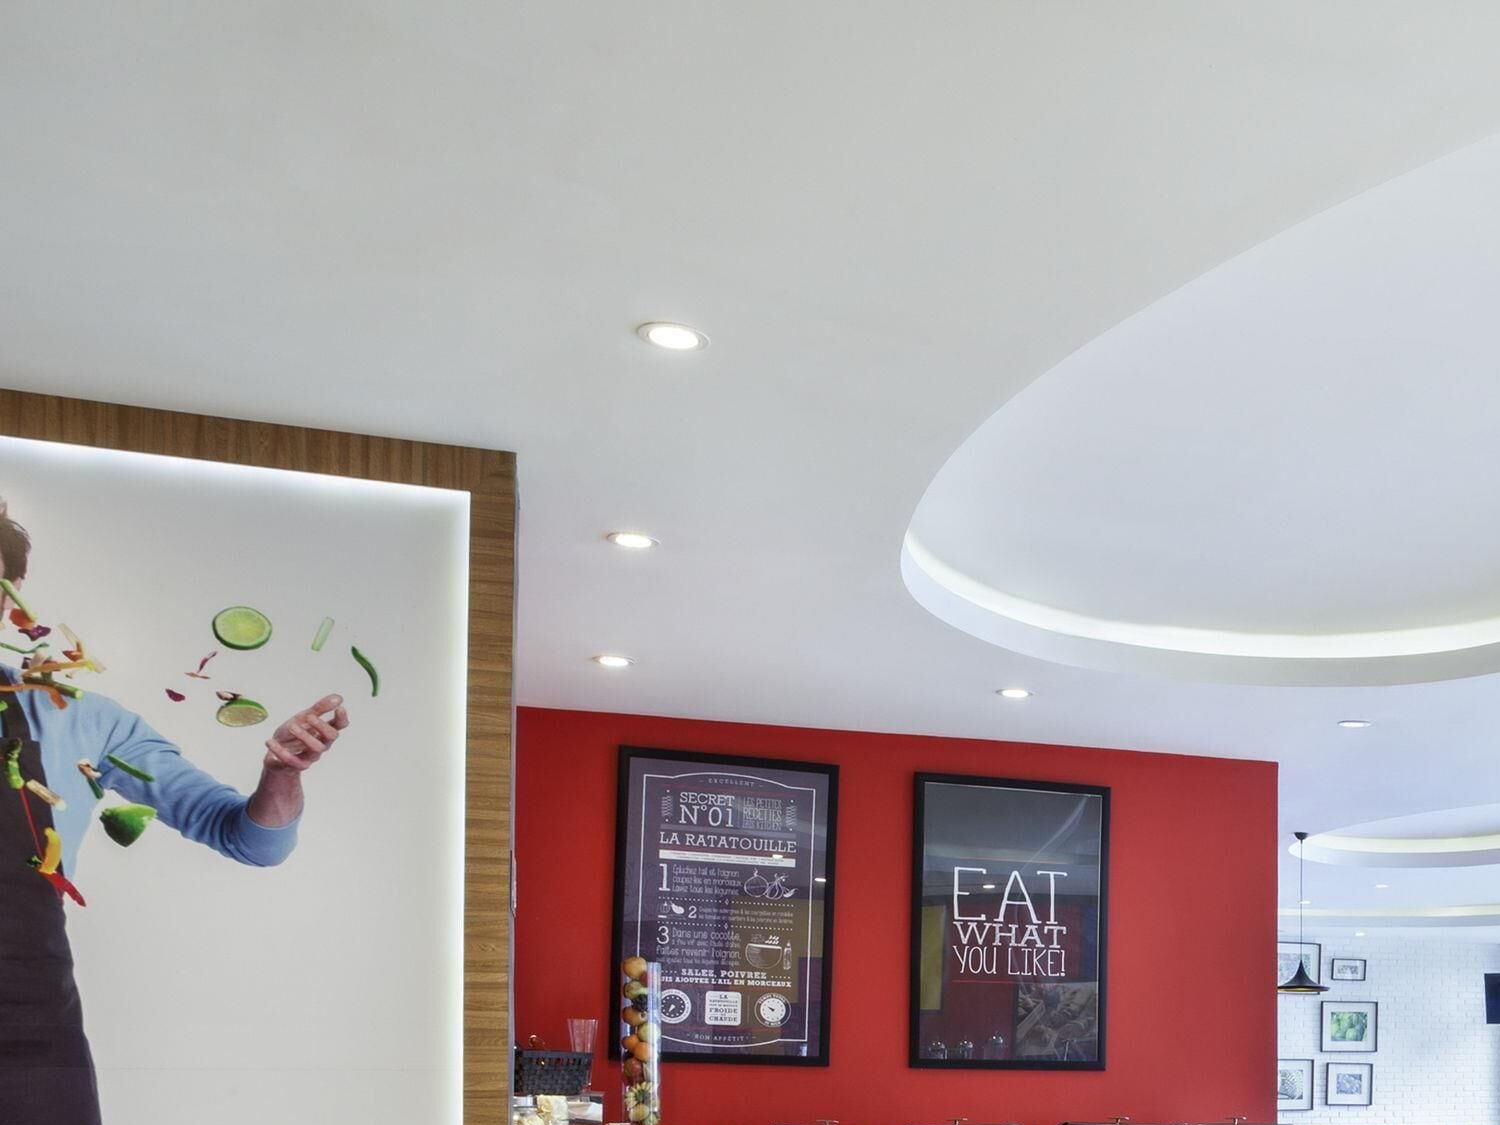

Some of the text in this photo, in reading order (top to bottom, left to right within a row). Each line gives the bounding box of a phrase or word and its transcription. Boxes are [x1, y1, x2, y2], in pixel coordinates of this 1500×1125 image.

[708, 778, 755, 787] EXCELLENT
[679, 791, 735, 807] SECRET
[659, 831, 797, 853] LA RATATOUILLE
[659, 863, 671, 892] 1
[953, 866, 1068, 925] EAT
[688, 905, 697, 919] 2
[656, 926, 669, 944] 3
[952, 921, 1067, 949] WHAT
[952, 945, 1066, 977] YOU LIKE!
[720, 970, 767, 980] POIVREZ
[747, 979, 792, 988] MORCEAUX
